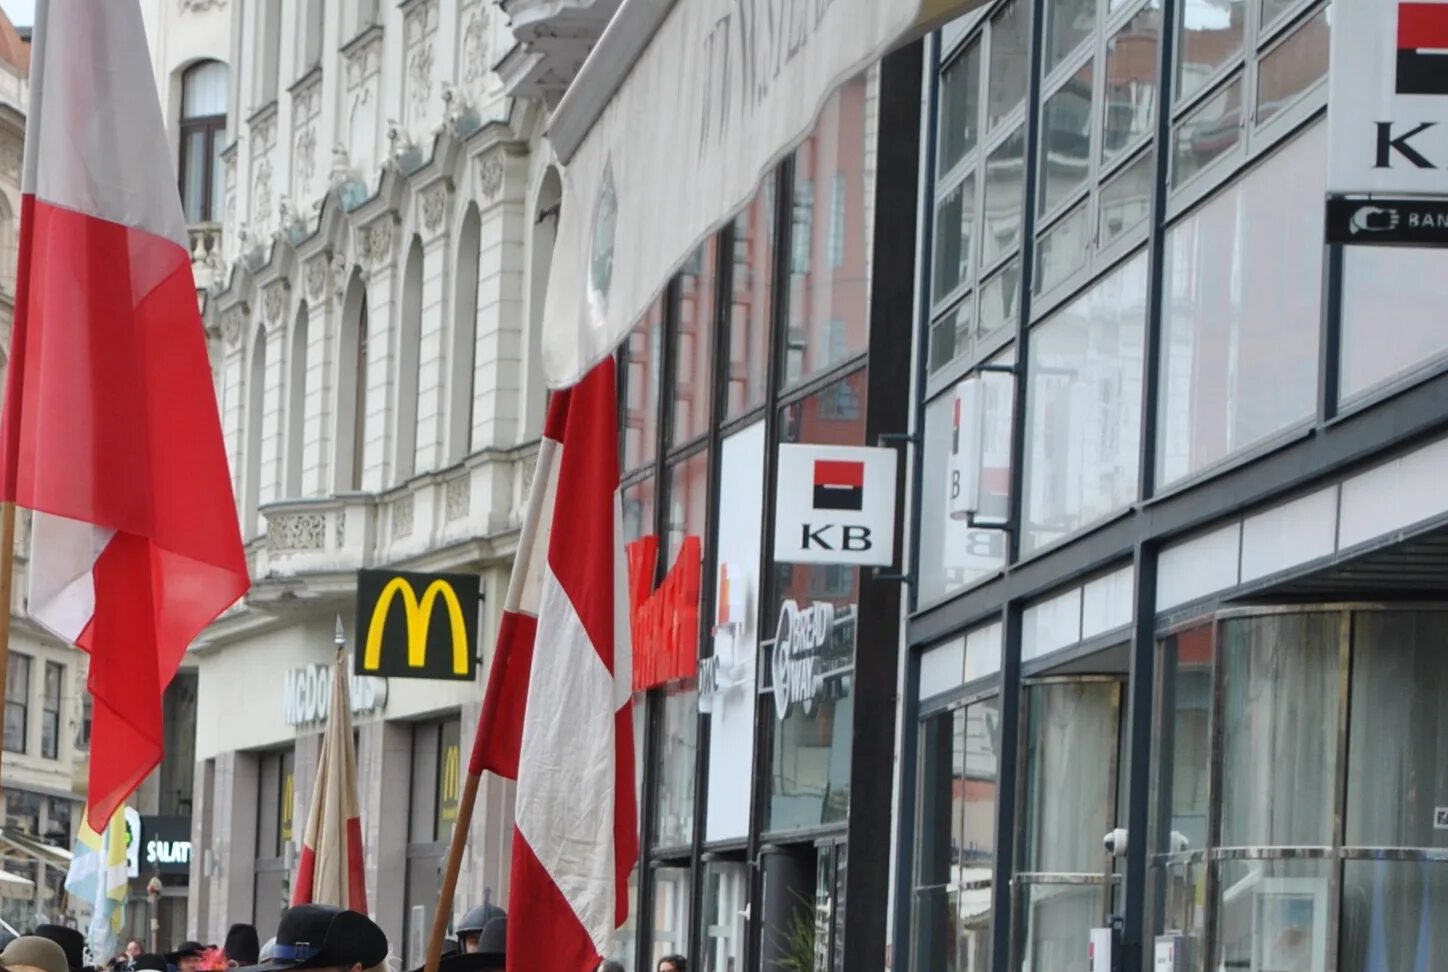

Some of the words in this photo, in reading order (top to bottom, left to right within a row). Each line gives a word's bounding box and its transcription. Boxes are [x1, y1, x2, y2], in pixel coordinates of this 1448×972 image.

[801, 523, 873, 551] KB
[791, 602, 827, 655] BREAD
[146, 840, 195, 863] SALAT
